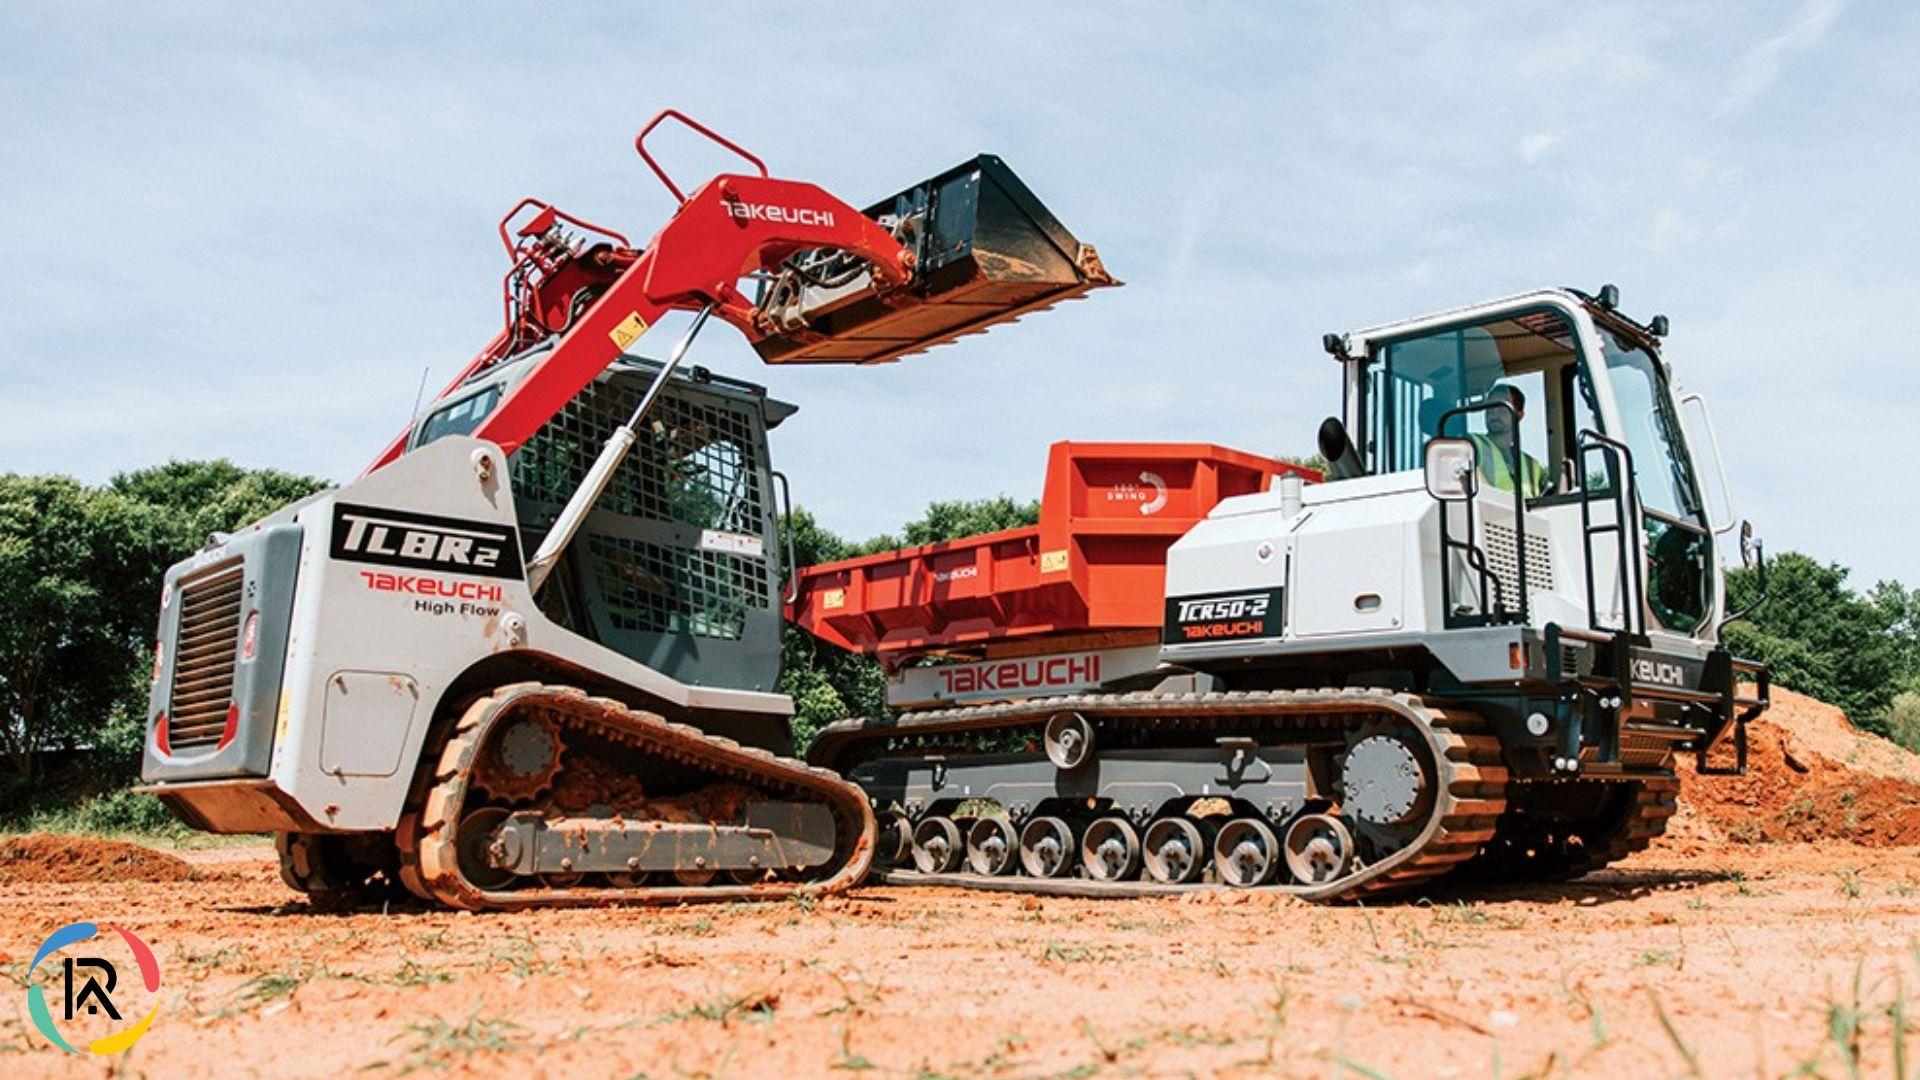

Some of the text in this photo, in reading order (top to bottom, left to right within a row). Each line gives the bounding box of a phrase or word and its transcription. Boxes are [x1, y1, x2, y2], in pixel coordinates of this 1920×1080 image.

[414, 600, 500, 617] High Flow
[1178, 593, 1270, 622] TCR50-2
